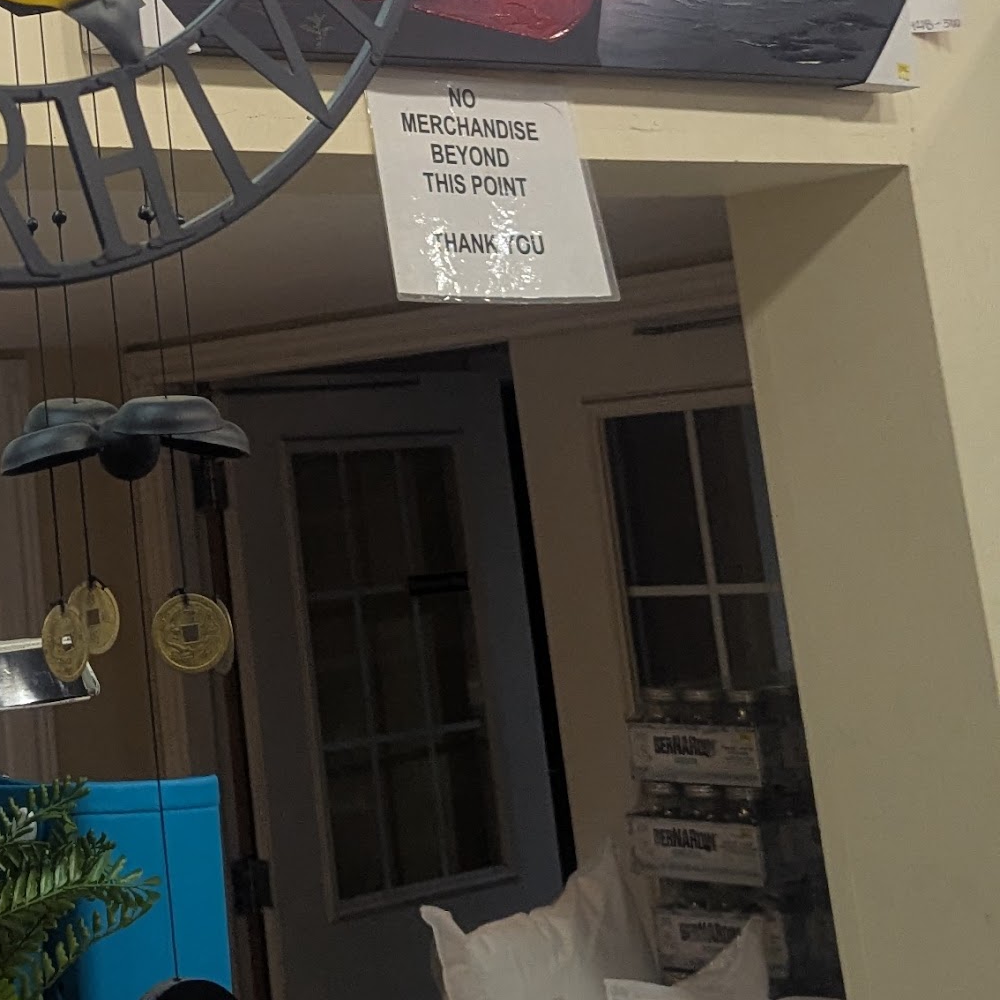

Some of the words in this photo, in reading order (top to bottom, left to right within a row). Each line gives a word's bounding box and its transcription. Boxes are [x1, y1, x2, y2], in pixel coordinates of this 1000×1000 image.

[448, 87, 476, 108] NO
[400, 112, 539, 141] MERCHANDISE
[430, 143, 510, 168] BEYOND
[422, 172, 466, 195] THIS
[471, 176, 527, 197] POINT
[433, 232, 498, 254] THANK
[502, 234, 545, 255] YOU
